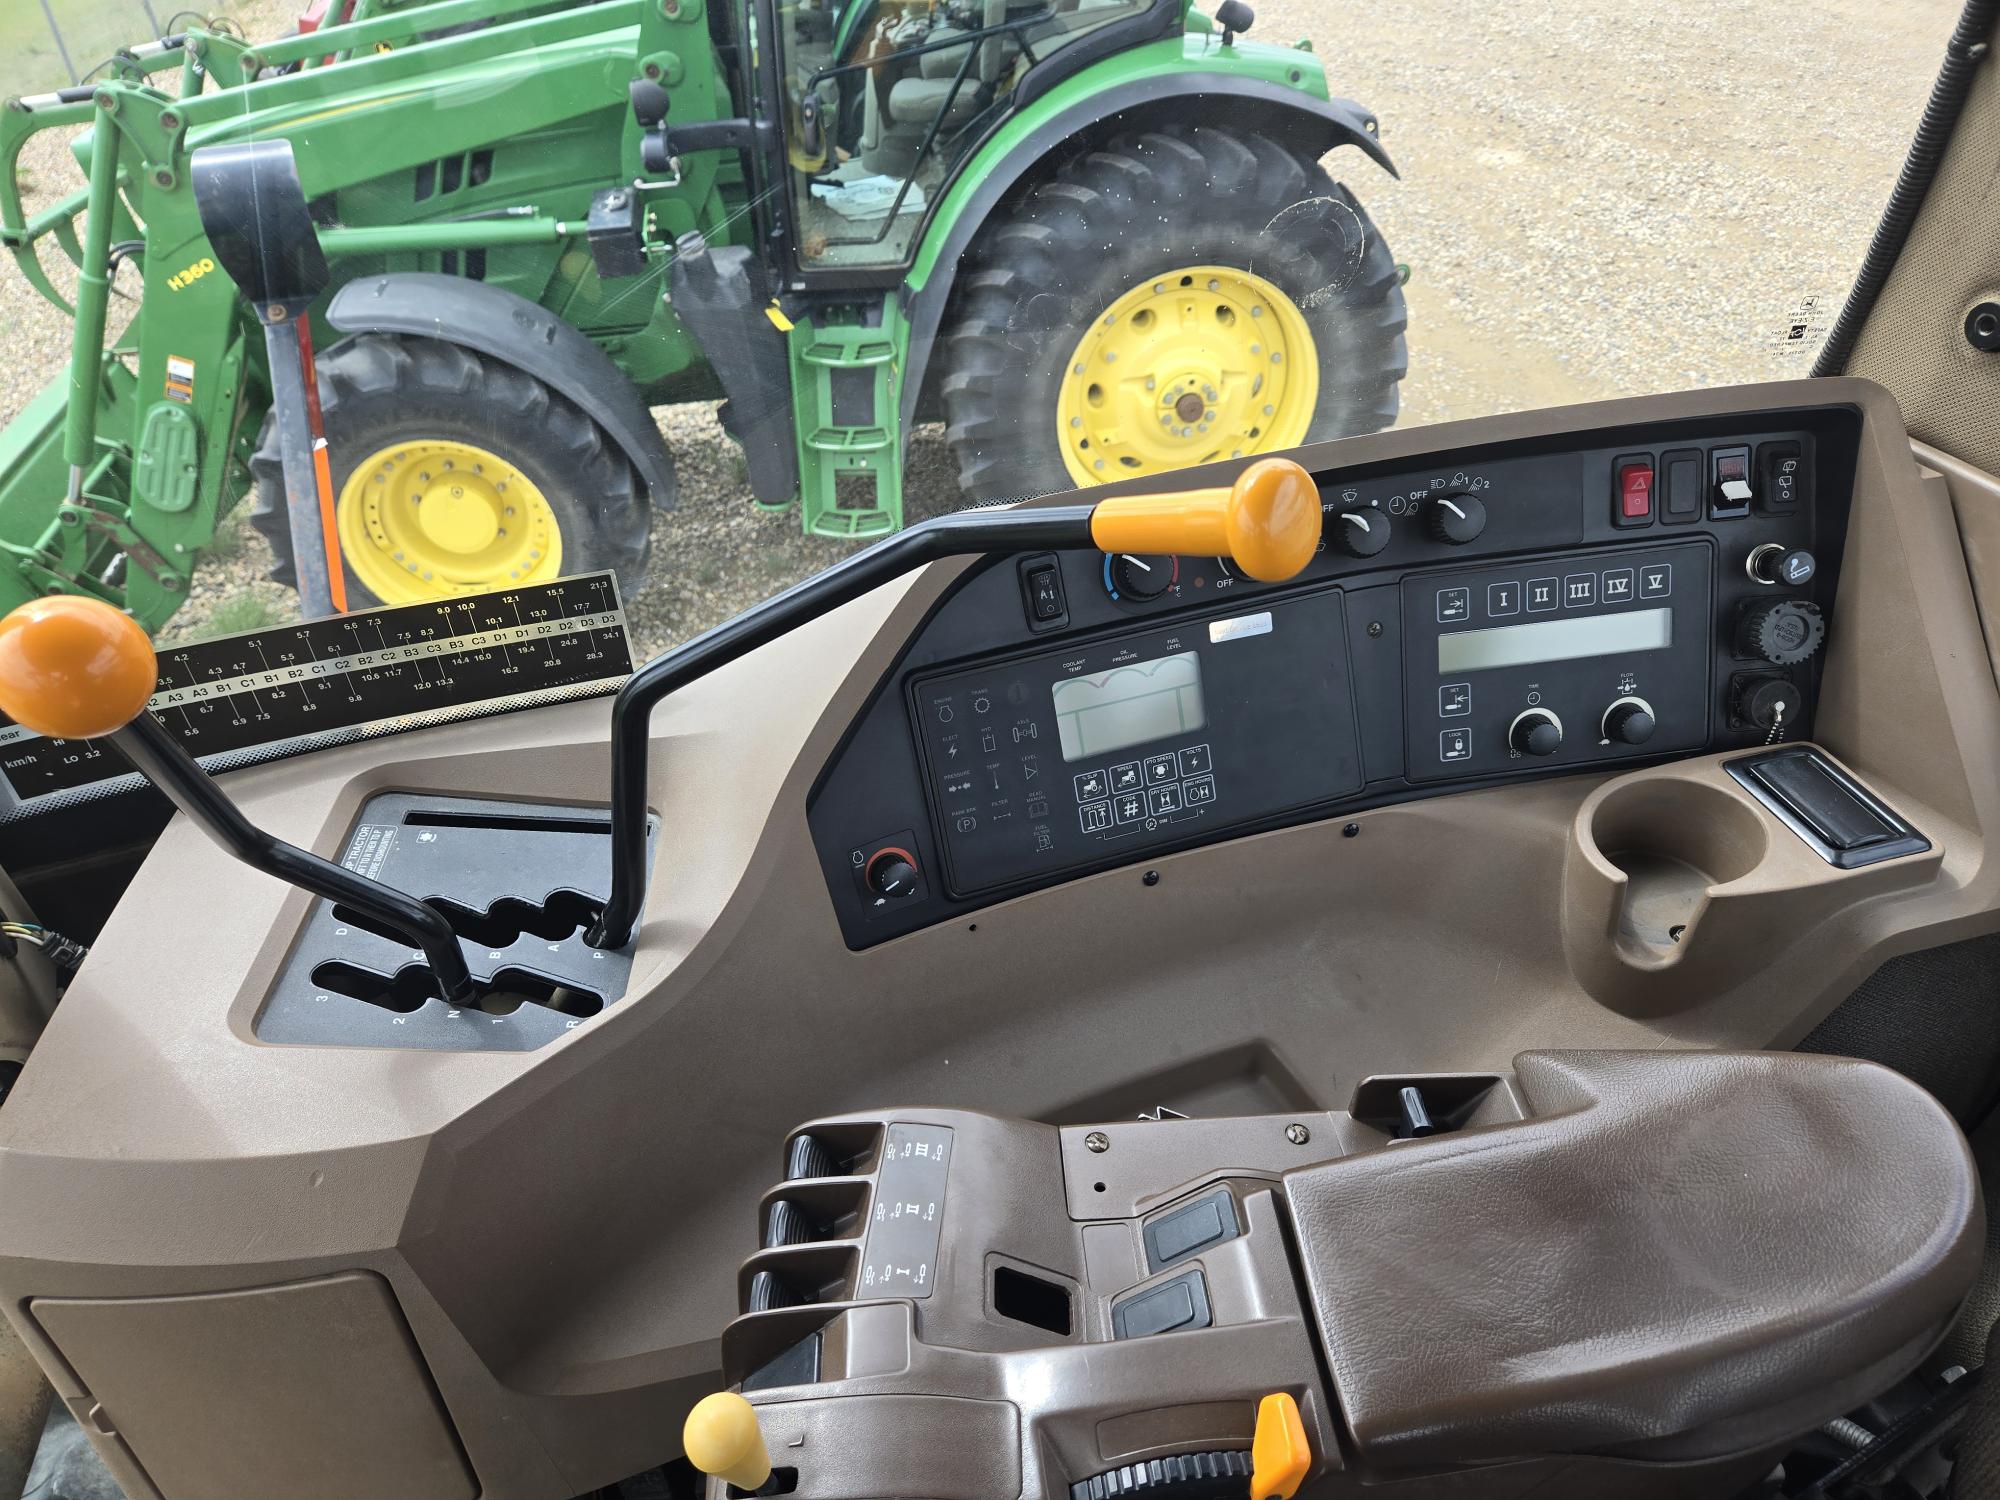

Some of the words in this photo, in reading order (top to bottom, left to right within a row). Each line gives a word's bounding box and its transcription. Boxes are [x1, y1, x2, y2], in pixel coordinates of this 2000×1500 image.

[1409, 491, 1429, 501] OFF
[1320, 504, 1334, 513] FF
[1216, 579, 1234, 589] OFF
[1607, 578, 1629, 594] IV
[1648, 574, 1663, 590] V
[1534, 587, 1549, 603] II
[1569, 582, 1590, 599] III
[1500, 592, 1508, 607] I
[174, 653, 189, 662] 4.2
[248, 640, 262, 648] 5.1
[296, 630, 310, 639] 5.7
[344, 622, 358, 631] 6.6
[367, 618, 382, 626] 7.3
[436, 606, 451, 615] 9.0
[457, 602, 476, 611] 10.0
[502, 595, 520, 604] 12.1
[546, 588, 564, 597] 15.5
[590, 581, 608, 590] 21.3
[158, 677, 173, 686] 3.5
[208, 667, 223, 675] 4.3
[232, 662, 246, 670] 4.7
[280, 653, 295, 661] 5.5
[327, 644, 341, 653] 6.1
[396, 632, 411, 640] 7.5
[420, 628, 434, 636] 8.3
[485, 617, 503, 625] 10.1
[529, 609, 548, 618] 13.0
[573, 602, 590, 611] 17.7
[1167, 637, 1179, 645] FUEL
[1166, 643, 1182, 651] LEVEL
[168, 693, 184, 703] A3
[192, 688, 209, 698] A3
[216, 683, 232, 693] B1
[240, 679, 256, 688] C1
[264, 674, 279, 683] B1
[288, 669, 304, 678] B2
[311, 665, 327, 674] C1
[334, 660, 351, 670] C2
[358, 656, 374, 666] B2
[381, 652, 397, 661] C2
[404, 648, 419, 657] B3
[426, 644, 442, 653] C3
[449, 640, 464, 649] B3
[471, 636, 487, 645] C3
[493, 633, 507, 641] D1
[515, 629, 529, 638] D1
[537, 625, 552, 634] D2
[559, 622, 573, 631] D2
[580, 618, 595, 627] D3
[601, 615, 616, 624] D3
[1112, 653, 1138, 663] PRESSURE
[1062, 658, 1086, 669] COOLANT
[53, 738, 65, 747] HI
[200, 705, 214, 714] 6.7
[272, 691, 286, 699] 8.2
[318, 682, 332, 690] 9.1
[361, 673, 380, 682] 10.6
[384, 669, 402, 678] 11.7
[452, 657, 470, 665] 14.4
[474, 653, 492, 662] 16.0
[517, 645, 535, 654] 19.4
[560, 638, 578, 647] 24.8
[602, 631, 619, 640] 34.1
[5, 755, 37, 769] km/h
[63, 755, 79, 764] LO
[85, 750, 101, 759] 3.2
[185, 728, 199, 736] 5.6
[232, 718, 247, 726] 6.9
[256, 712, 271, 721] 7.5
[303, 703, 317, 712] 8.8
[348, 694, 363, 703] 9.8
[413, 682, 432, 690] 12.0
[436, 678, 454, 687] 13.3
[501, 666, 519, 675] 16.2
[544, 659, 562, 667] 20.8
[586, 651, 603, 660] 28.3
[942, 734, 958, 742] ELECT
[1021, 754, 1037, 762] LEVEL
[986, 762, 1000, 770] TEMP
[1117, 764, 1133, 772] SPEED
[943, 769, 971, 780] PRESSURE
[1194, 776, 1211, 784] HOURS
[1160, 785, 1177, 793] HOURS
[991, 798, 1009, 807] FILTER
[1083, 803, 1106, 812] DISTANCE
[348, 826, 371, 861] TRACTOR
[335, 928, 348, 936] D
[547, 944, 560, 952] A
[412, 952, 425, 960] C
[488, 951, 501, 959] B
[447, 1010, 461, 1018] N
[392, 1017, 406, 1025] 2
[566, 1020, 579, 1029] R
